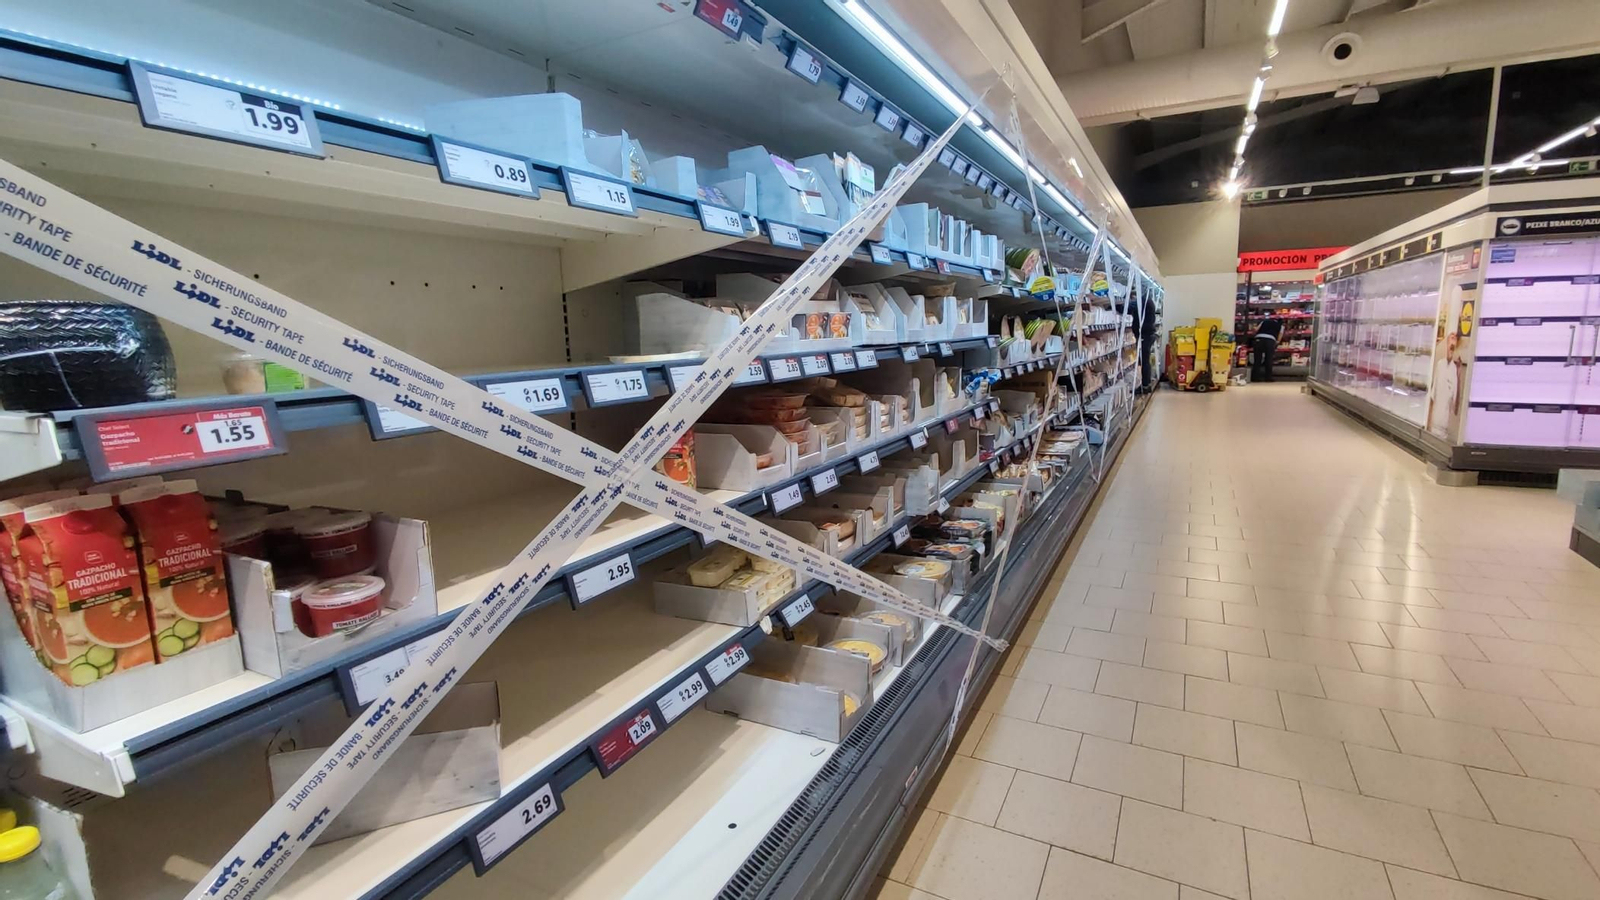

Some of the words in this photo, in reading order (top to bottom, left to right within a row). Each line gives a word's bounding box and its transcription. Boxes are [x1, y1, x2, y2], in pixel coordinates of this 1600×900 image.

[263, 99, 280, 111] Bio
[245, 107, 299, 135] 1.99
[494, 163, 527, 183] 0.89
[606, 188, 627, 204] 1.15
[38, 218, 74, 243] TAPE
[724, 216, 741, 229] 1.99
[12, 231, 63, 262] BANDE
[62, 253, 84, 270] DE
[83, 264, 149, 298] SÉCURITÉ
[193, 268, 288, 319] SICHERUNGSBAND
[231, 305, 281, 334] SECURITY
[282, 326, 305, 345] TAPE
[264, 339, 298, 361] BANDE
[298, 352, 311, 366] DE
[311, 359, 354, 383] SÉCURITÉ
[748, 366, 763, 377] 2.59
[382, 355, 446, 391] SICHERUNGSBAND
[532, 386, 560, 403] 1.69
[622, 378, 643, 392] 1.75
[406, 382, 441, 402] SECURITY
[440, 397, 457, 411] TAPE
[428, 407, 452, 425] BANDE
[451, 416, 461, 427] DE
[459, 421, 489, 439] SÉCURITÉ
[100, 431, 136, 441] Gazpacho
[101, 436, 141, 447] tradicional
[210, 425, 256, 445] 1.55
[525, 435, 550, 452] SECURITY
[549, 445, 563, 457] TAPE
[788, 489, 800, 501] 1.49
[158, 547, 213, 569] TRADICIONAL
[165, 542, 202, 556] GAZPACHO
[66, 567, 129, 591] TRADICIONAL
[75, 561, 117, 577] GAZPACHO
[608, 562, 631, 582] 2.95
[462, 608, 481, 630] BANDE
[482, 598, 508, 627] SECURITY
[486, 587, 530, 635] SICHERUNGSBAND
[453, 626, 465, 639] DE
[468, 623, 484, 639] TAPE
[425, 634, 456, 667] SÉCURITÉ
[729, 649, 745, 667] 2.99
[684, 680, 704, 699] 2.99
[366, 714, 399, 752] SECURITY
[372, 698, 429, 761] SICHERUNGSBAND
[633, 720, 651, 739] 2.09
[338, 732, 363, 760] BANDE
[326, 757, 340, 772] DE
[345, 750, 366, 770] TAPE
[286, 770, 329, 812] SÉCURITÉ
[521, 794, 552, 825] 2.69
